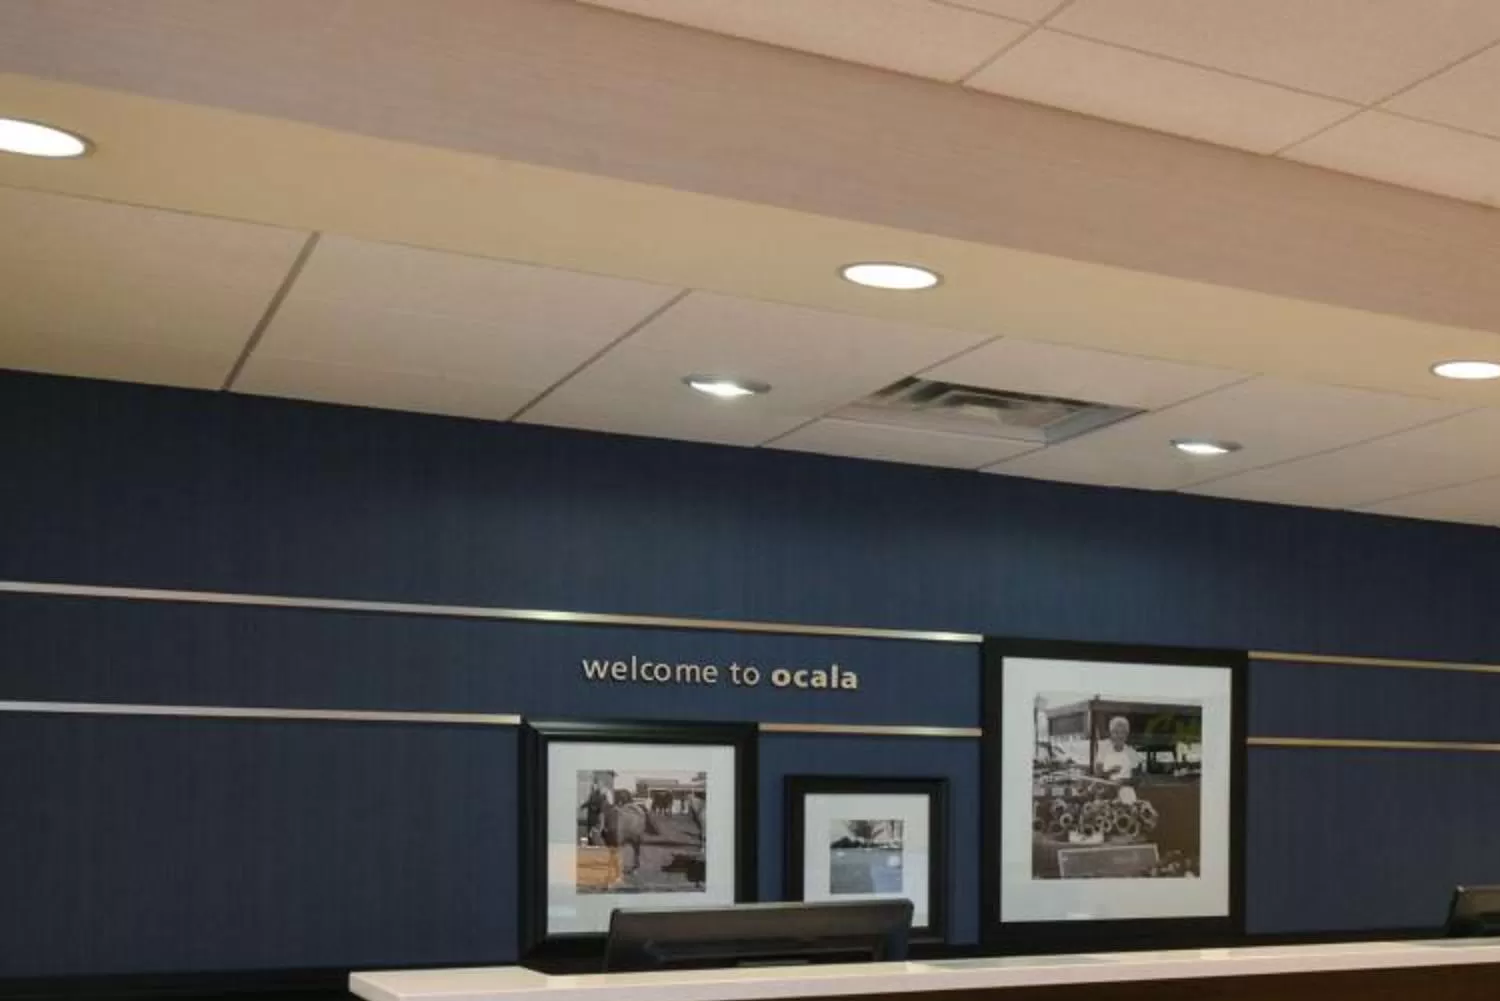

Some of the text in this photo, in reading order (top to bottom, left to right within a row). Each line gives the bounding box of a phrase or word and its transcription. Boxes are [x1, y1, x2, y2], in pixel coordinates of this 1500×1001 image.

[582, 656, 858, 690] welcome to ocala
